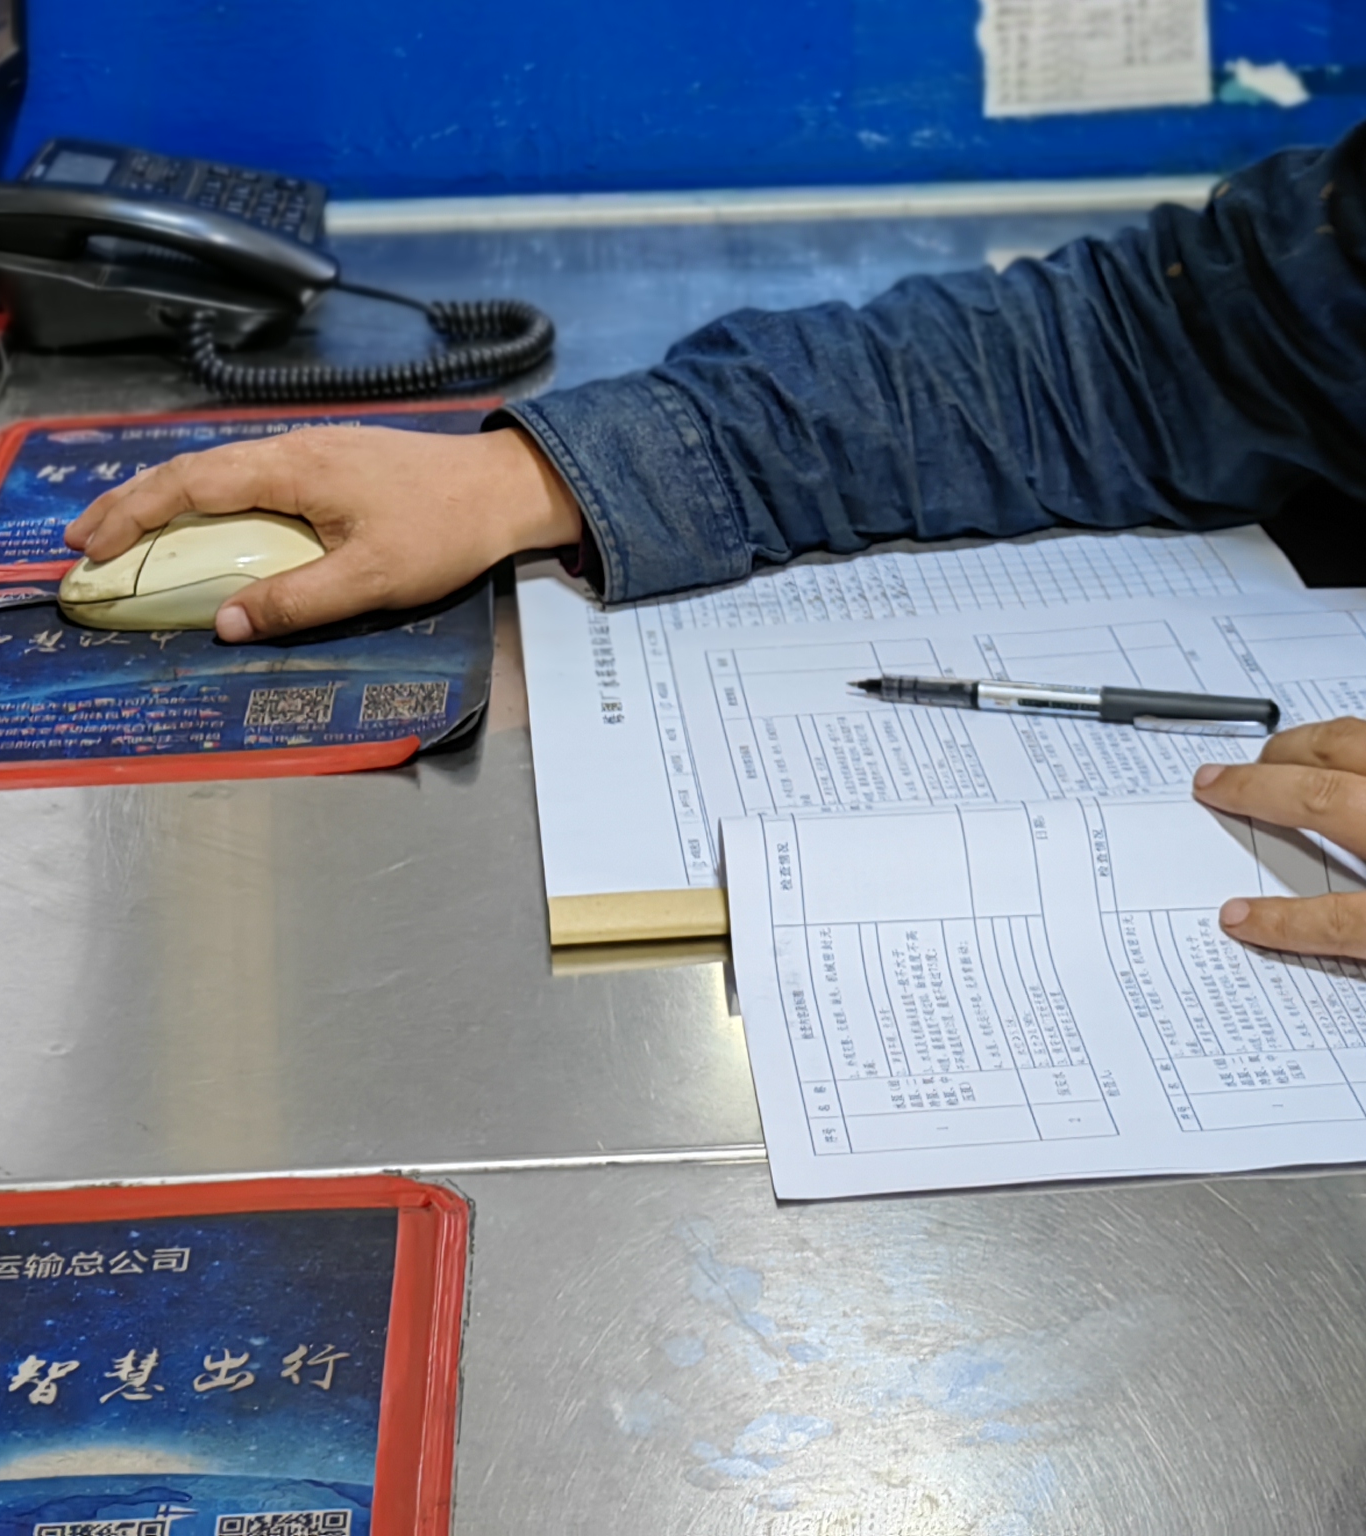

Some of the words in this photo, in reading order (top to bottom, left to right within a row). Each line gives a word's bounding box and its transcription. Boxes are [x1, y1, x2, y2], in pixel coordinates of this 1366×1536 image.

[776, 841, 793, 891] 检查情况
[1092, 828, 1109, 878] 检查情况
[8, 1342, 351, 1405] 智慧出行
